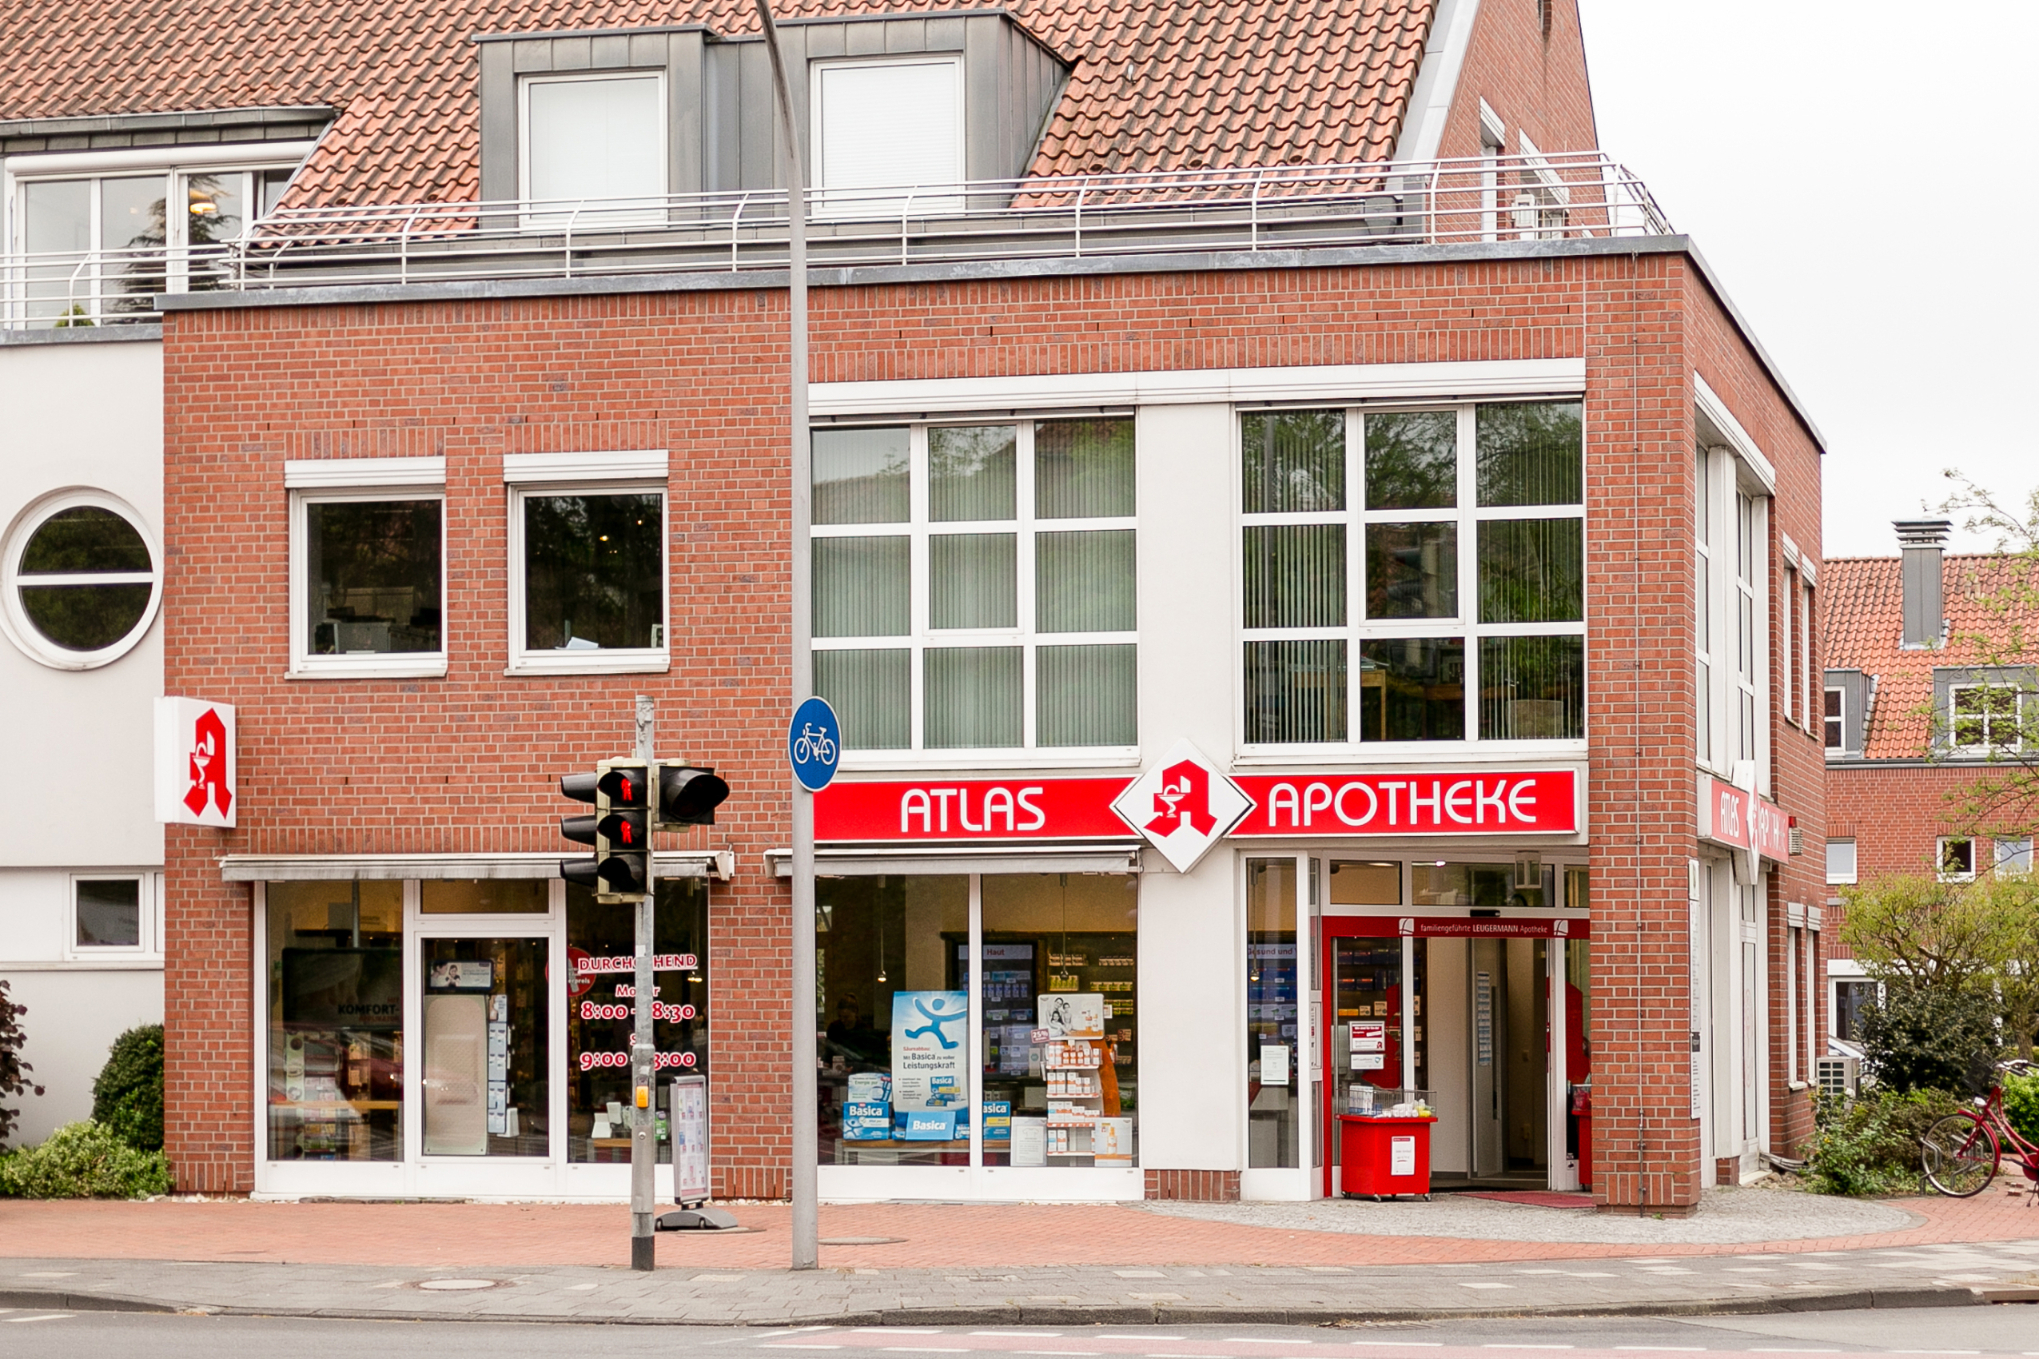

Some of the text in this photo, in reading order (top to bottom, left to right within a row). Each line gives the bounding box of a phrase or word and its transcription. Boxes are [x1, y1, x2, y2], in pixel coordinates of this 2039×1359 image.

[1268, 778, 1538, 828] APOTHEKE
[900, 786, 1045, 833] ATLAS
[1720, 790, 1739, 838] ATLAS
[1420, 923, 1548, 934] familiengeführte LEUGERMANN Apotheke
[986, 948, 1005, 956] Haut
[578, 954, 698, 973] DURCHHEND
[581, 1001, 628, 1019] 8:00
[651, 1001, 696, 1023] 8:30
[580, 1052, 696, 1071] 9:00 3:00
[911, 1052, 936, 1060] Basica
[903, 1061, 955, 1070] Leistungskraft
[849, 1105, 882, 1116] Basica
[982, 1103, 1007, 1113] asica
[912, 1120, 946, 1130] Basica
